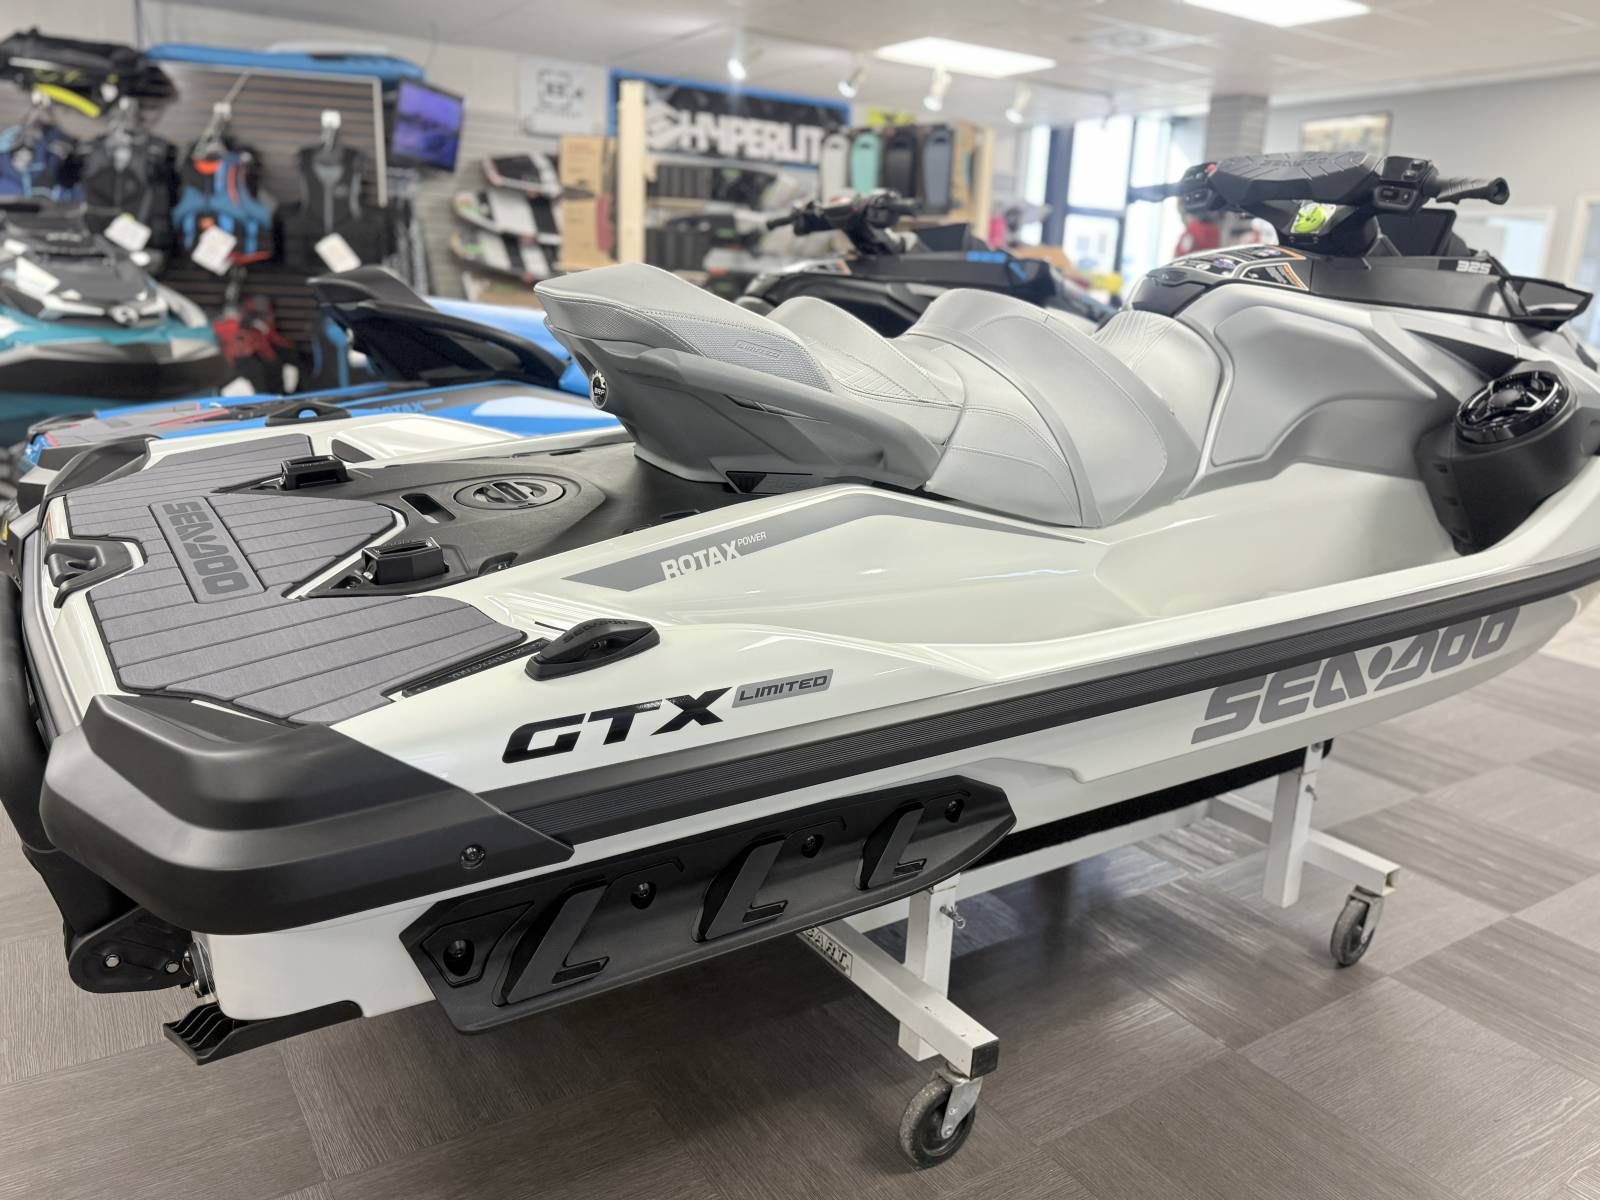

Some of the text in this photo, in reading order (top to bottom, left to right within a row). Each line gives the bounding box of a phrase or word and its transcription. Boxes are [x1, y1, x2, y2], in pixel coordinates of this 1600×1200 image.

[680, 108, 828, 164] HYPERLIT
[661, 531, 767, 581] ROTAX POWER
[501, 675, 829, 764] GTX LIMITED
